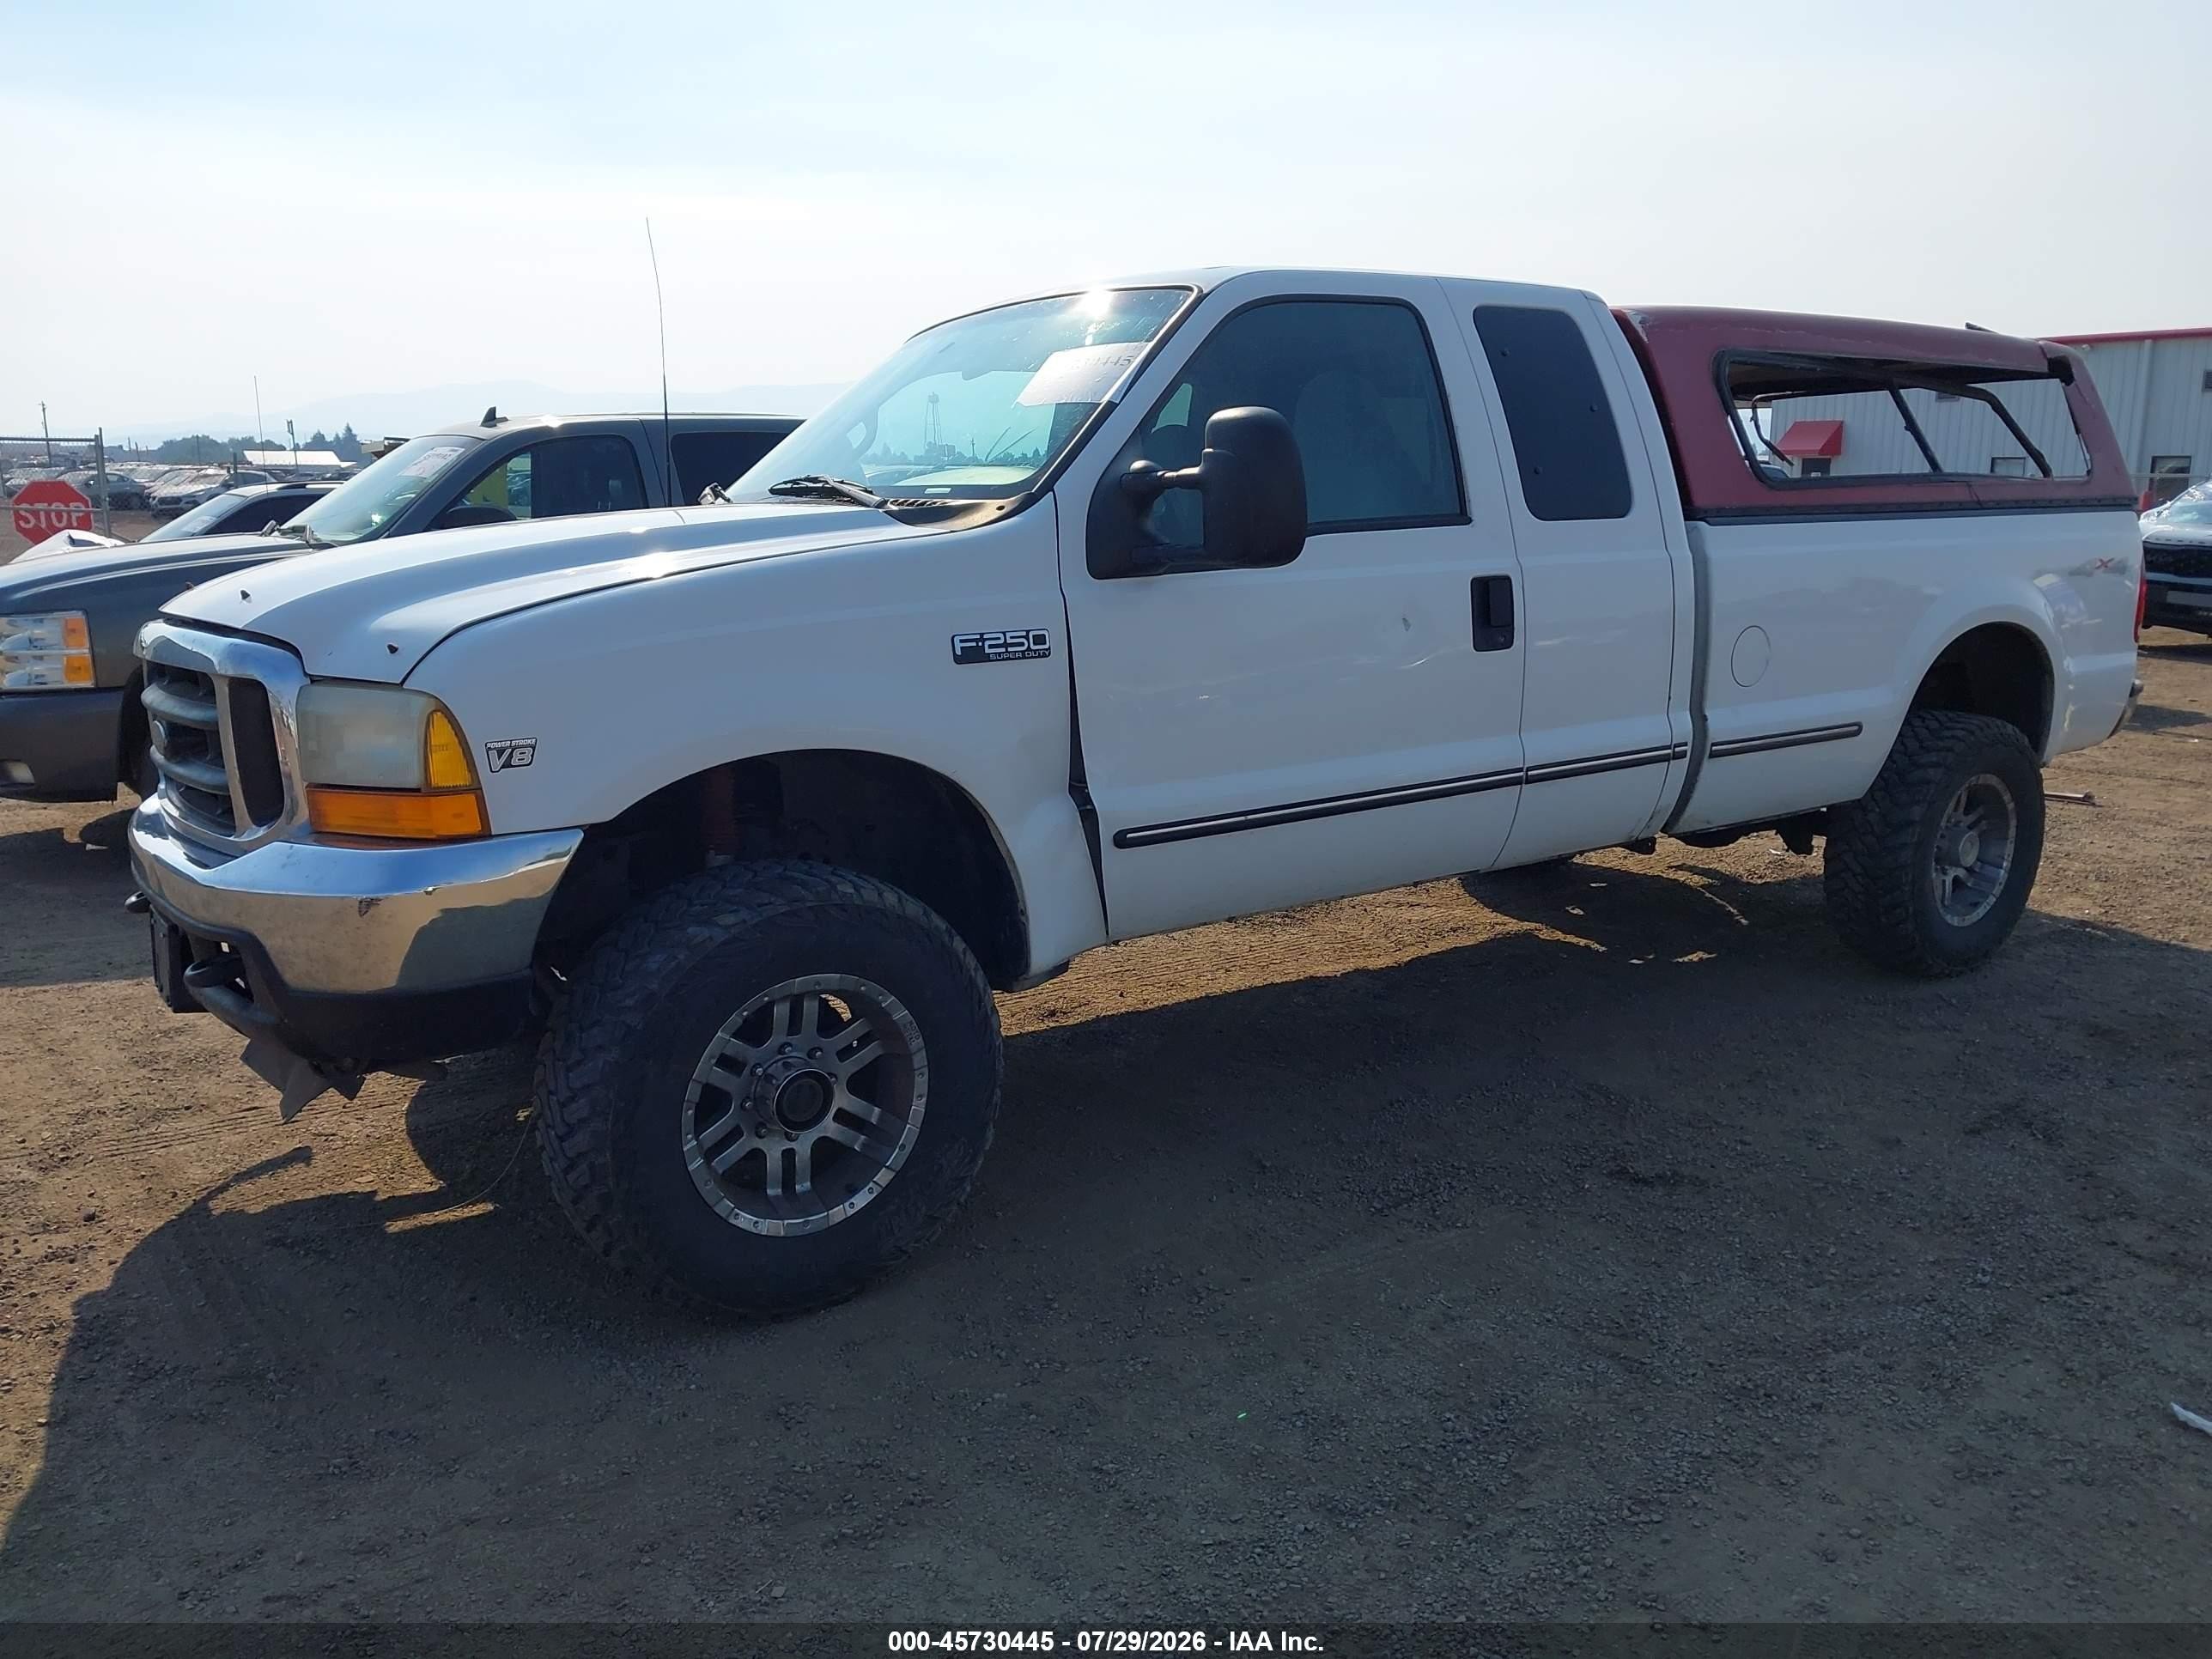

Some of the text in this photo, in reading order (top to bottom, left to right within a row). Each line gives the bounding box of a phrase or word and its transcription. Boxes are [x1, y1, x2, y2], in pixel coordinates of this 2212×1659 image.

[18, 502, 86, 528] STOP
[989, 649, 1051, 660] SUPER DUTY
[511, 738, 537, 747] STROKE
[488, 747, 533, 772] V8
